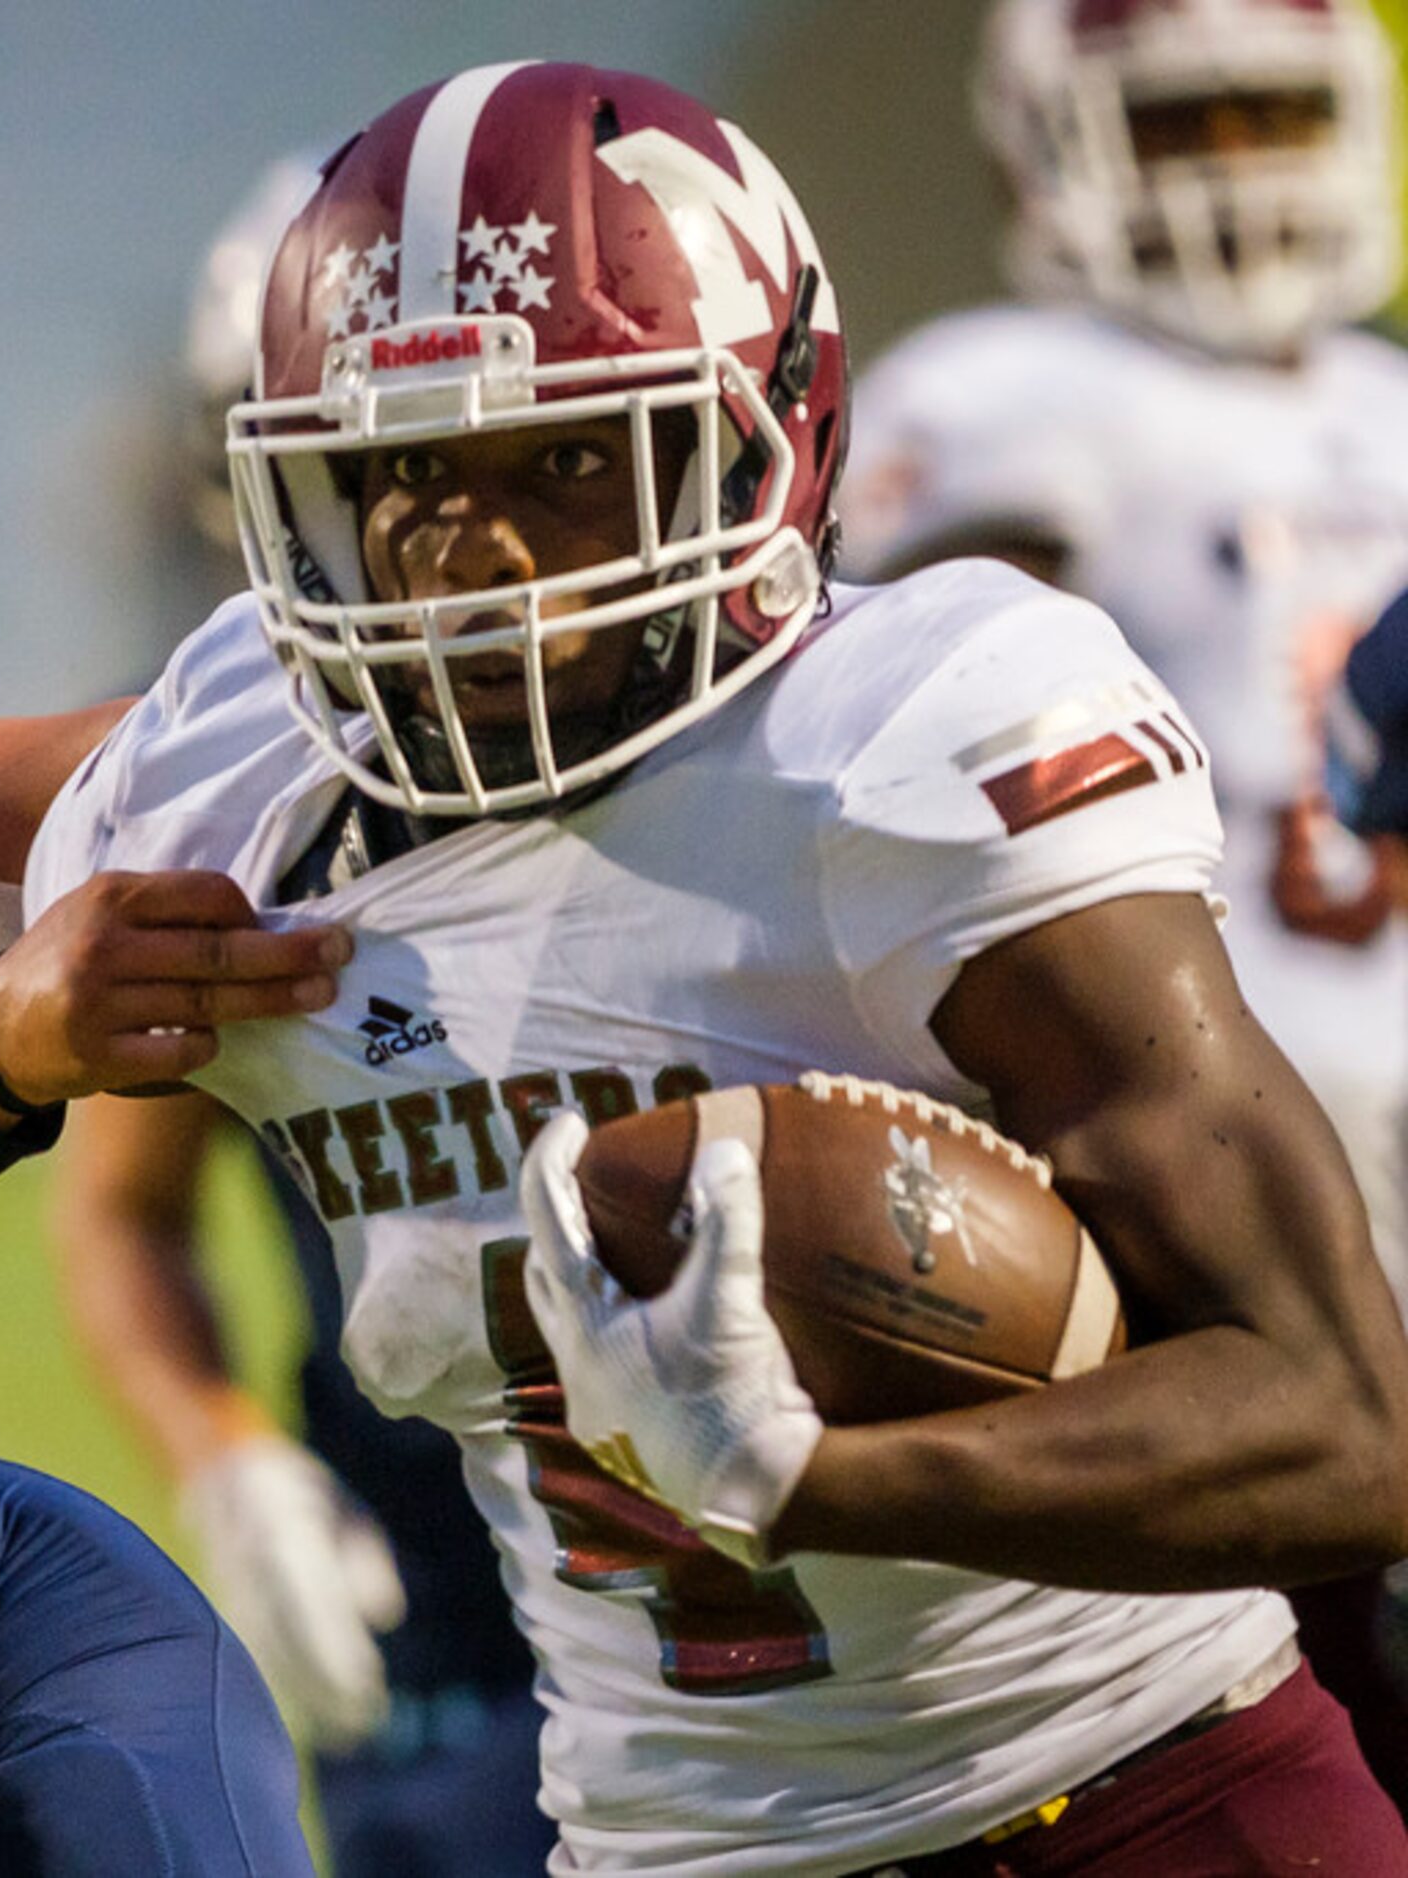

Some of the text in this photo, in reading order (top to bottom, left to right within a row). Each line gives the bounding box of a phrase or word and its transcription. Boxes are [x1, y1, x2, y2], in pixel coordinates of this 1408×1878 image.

[594, 118, 841, 348] M
[371, 324, 482, 371] Riddell
[365, 1019, 448, 1068] adidas
